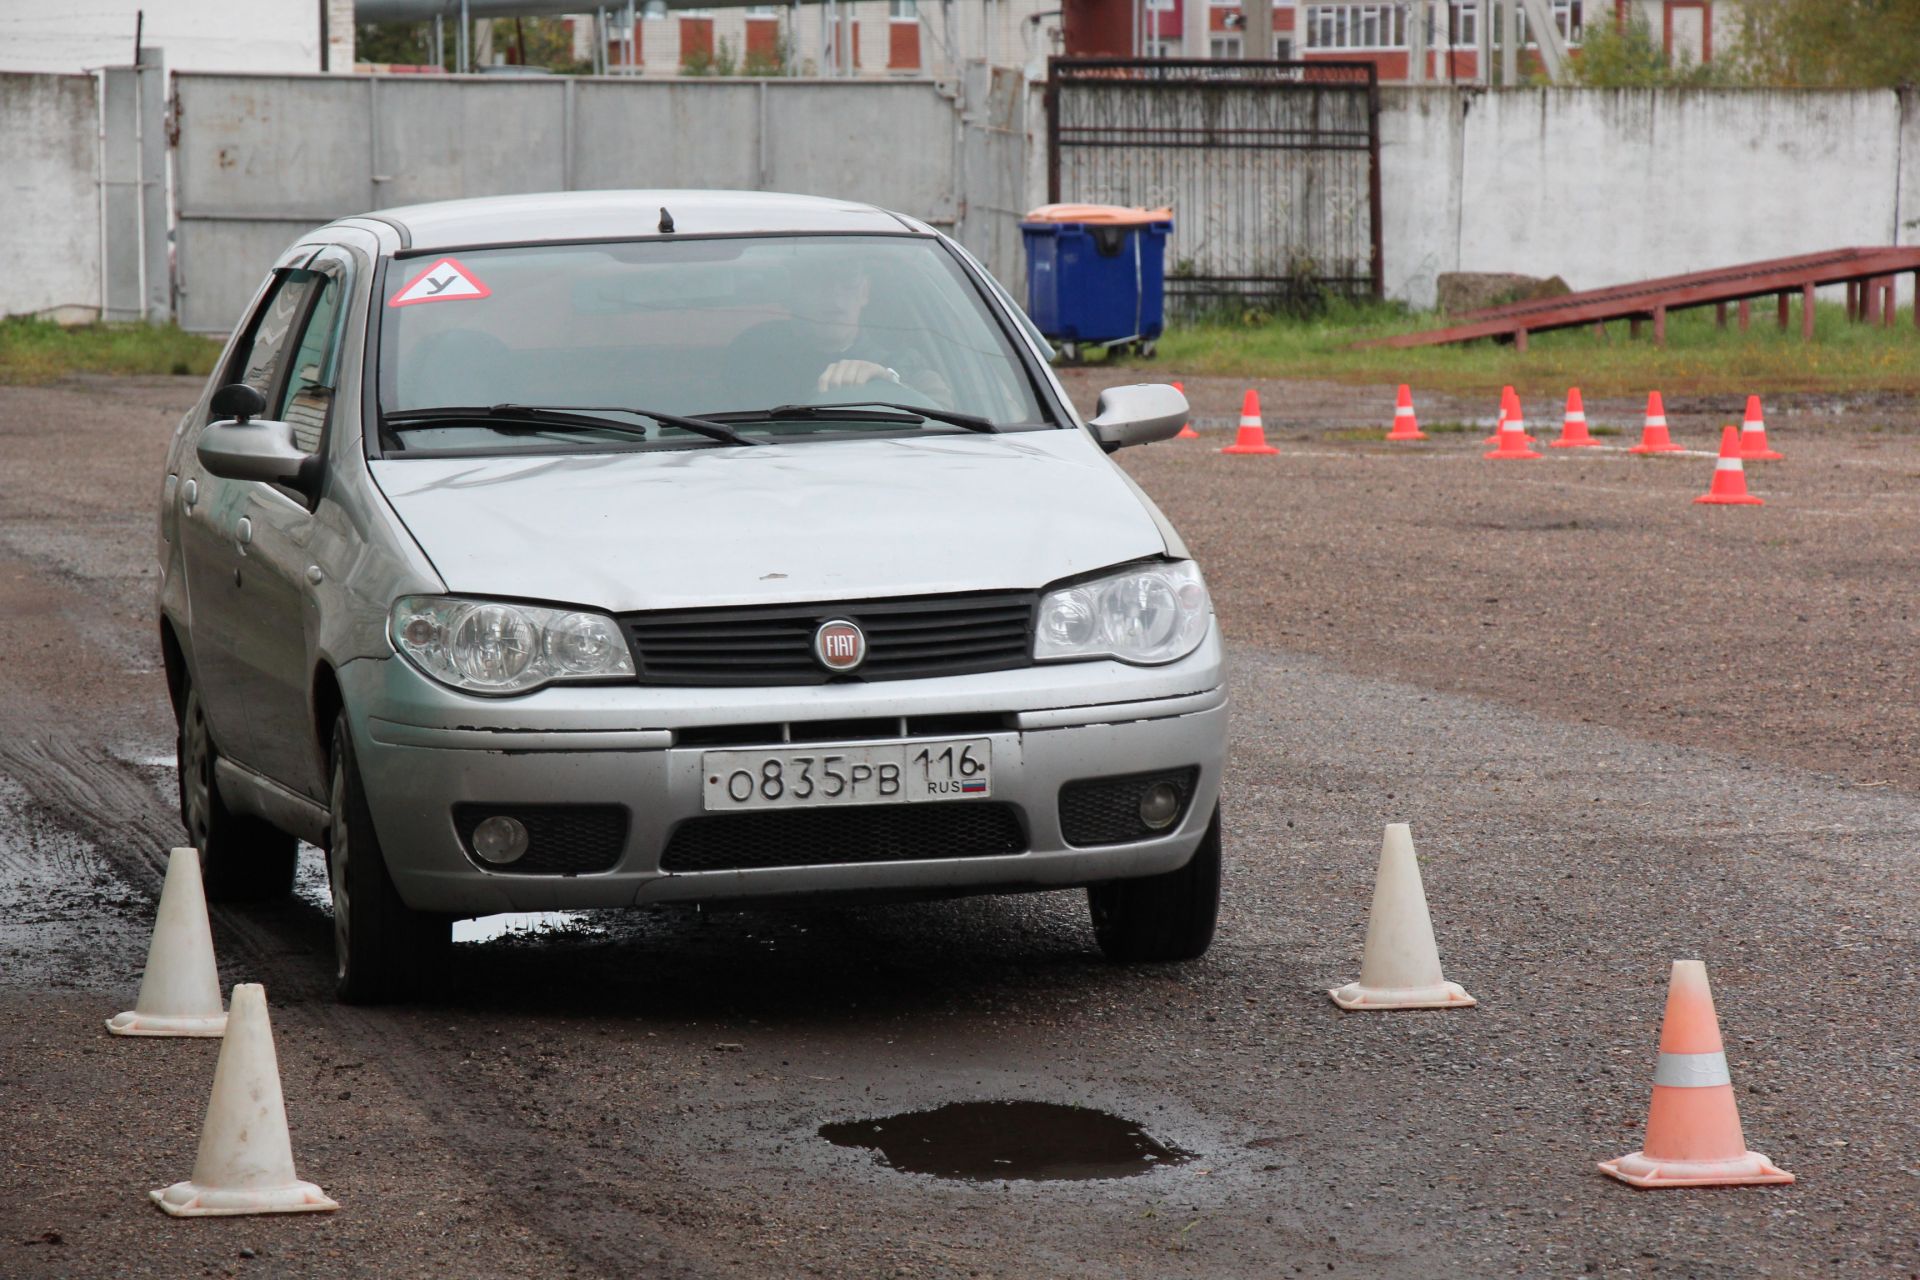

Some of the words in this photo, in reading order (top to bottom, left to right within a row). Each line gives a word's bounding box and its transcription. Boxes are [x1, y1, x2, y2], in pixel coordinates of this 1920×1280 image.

[825, 634, 856, 657] FIAT
[913, 744, 978, 779] 116
[927, 780, 960, 794] RUS
